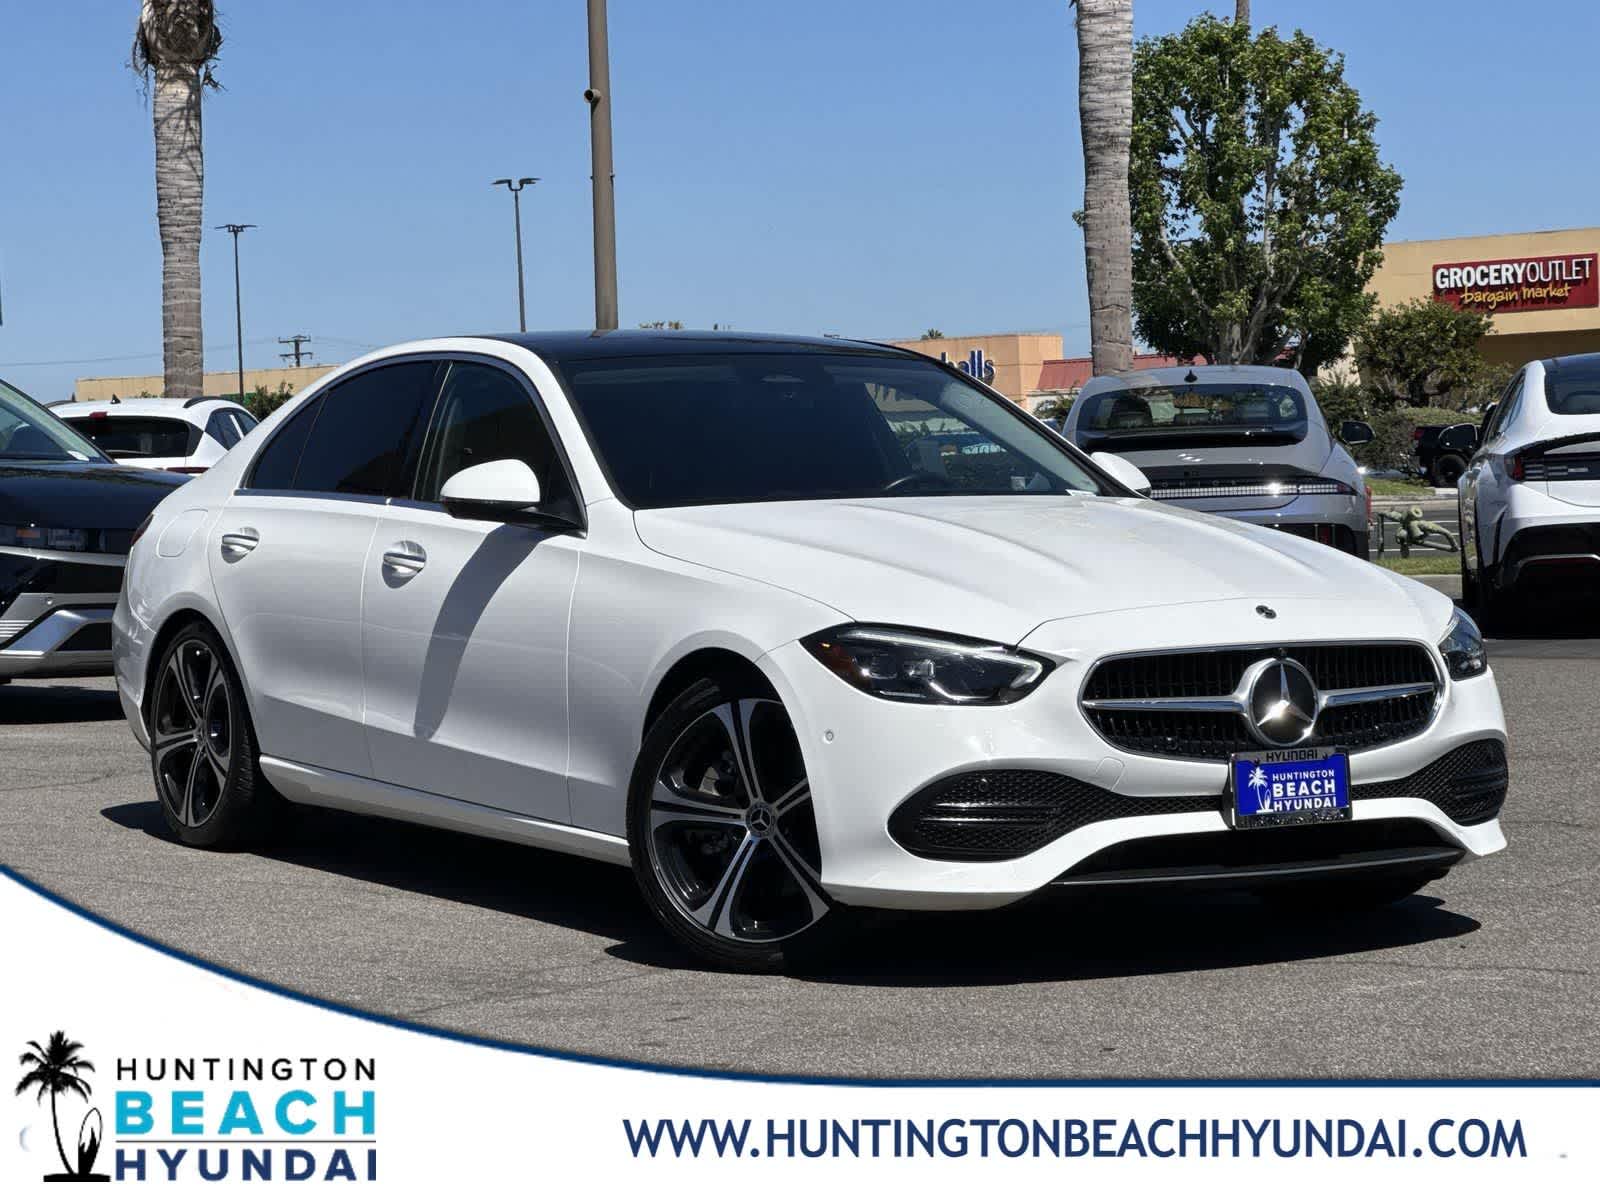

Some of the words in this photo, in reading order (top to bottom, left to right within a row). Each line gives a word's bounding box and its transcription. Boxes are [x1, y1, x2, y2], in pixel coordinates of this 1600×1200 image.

[1460, 284, 1518, 309] bargain
[1522, 283, 1571, 299] market
[1266, 750, 1318, 761] HYUNDAI
[1272, 769, 1335, 781] HUNTINGTON
[1272, 779, 1336, 798] BEACH
[1273, 796, 1337, 812] HYUNDAI
